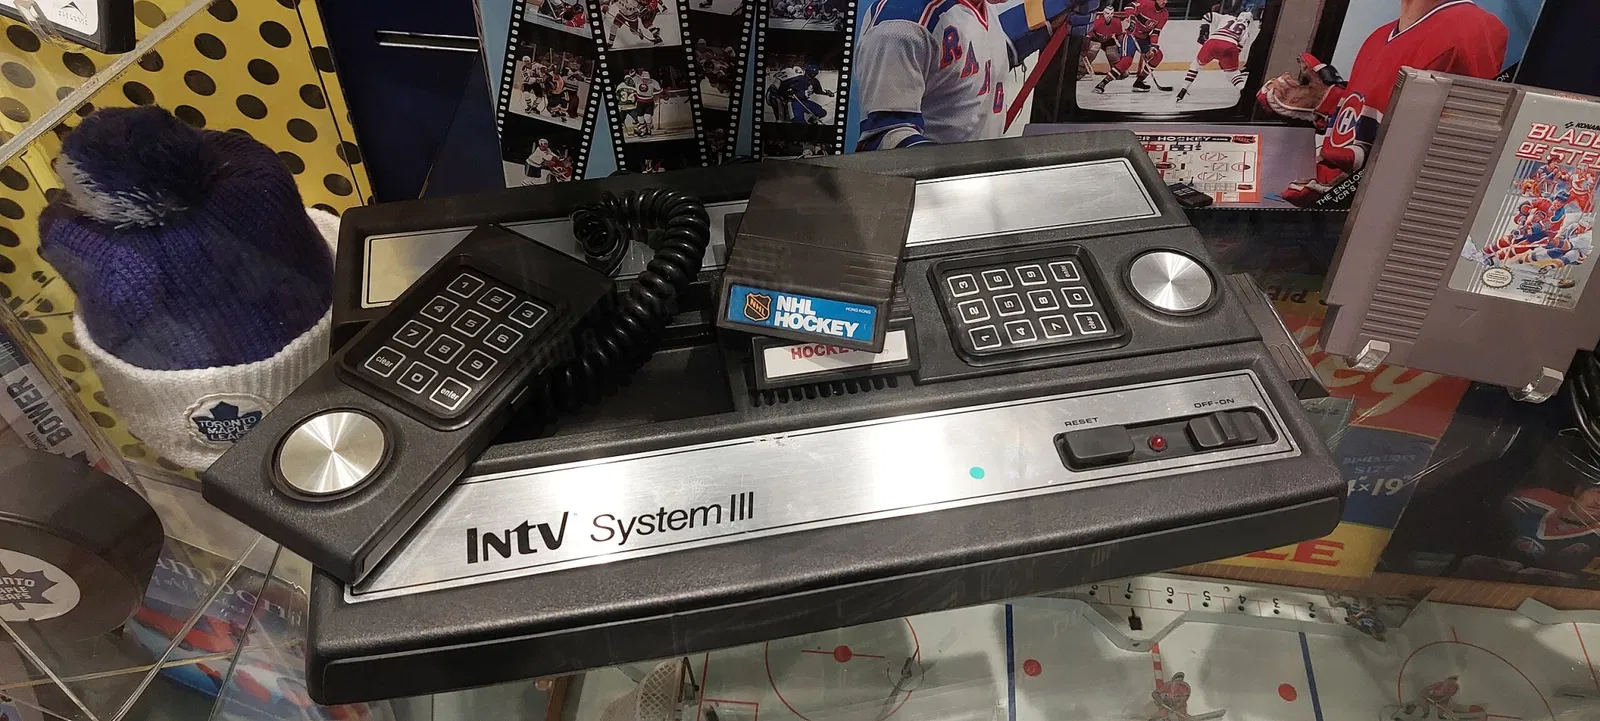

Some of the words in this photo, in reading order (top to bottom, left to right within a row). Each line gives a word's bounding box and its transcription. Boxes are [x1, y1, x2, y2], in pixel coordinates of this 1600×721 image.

[1517, 141, 1549, 157] OF
[1548, 146, 1600, 169] STE
[1316, 193, 1332, 206] THE
[1332, 185, 1356, 203] VCR'S
[461, 281, 468, 289] 1
[522, 310, 533, 318] 3
[749, 298, 766, 317] NHL
[776, 295, 816, 316] NHL
[433, 305, 443, 313] 4
[465, 320, 477, 328] 5
[497, 335, 508, 343] 6
[774, 311, 859, 337] HOCKEY
[407, 328, 419, 337] 7
[439, 346, 450, 354] 8
[471, 360, 483, 370] 9
[790, 343, 858, 360] HOCKE
[375, 355, 394, 368] clear
[440, 388, 460, 401] enter
[6, 375, 73, 447] BOWER
[1193, 397, 1235, 409] OFF-ON
[198, 416, 257, 428] TORONTO
[207, 424, 252, 434] MAPLE
[1064, 416, 1099, 427] RESET
[590, 503, 722, 546] System
[729, 492, 754, 522] III
[1203, 590, 1211, 601] 5
[1238, 594, 1247, 604] 4
